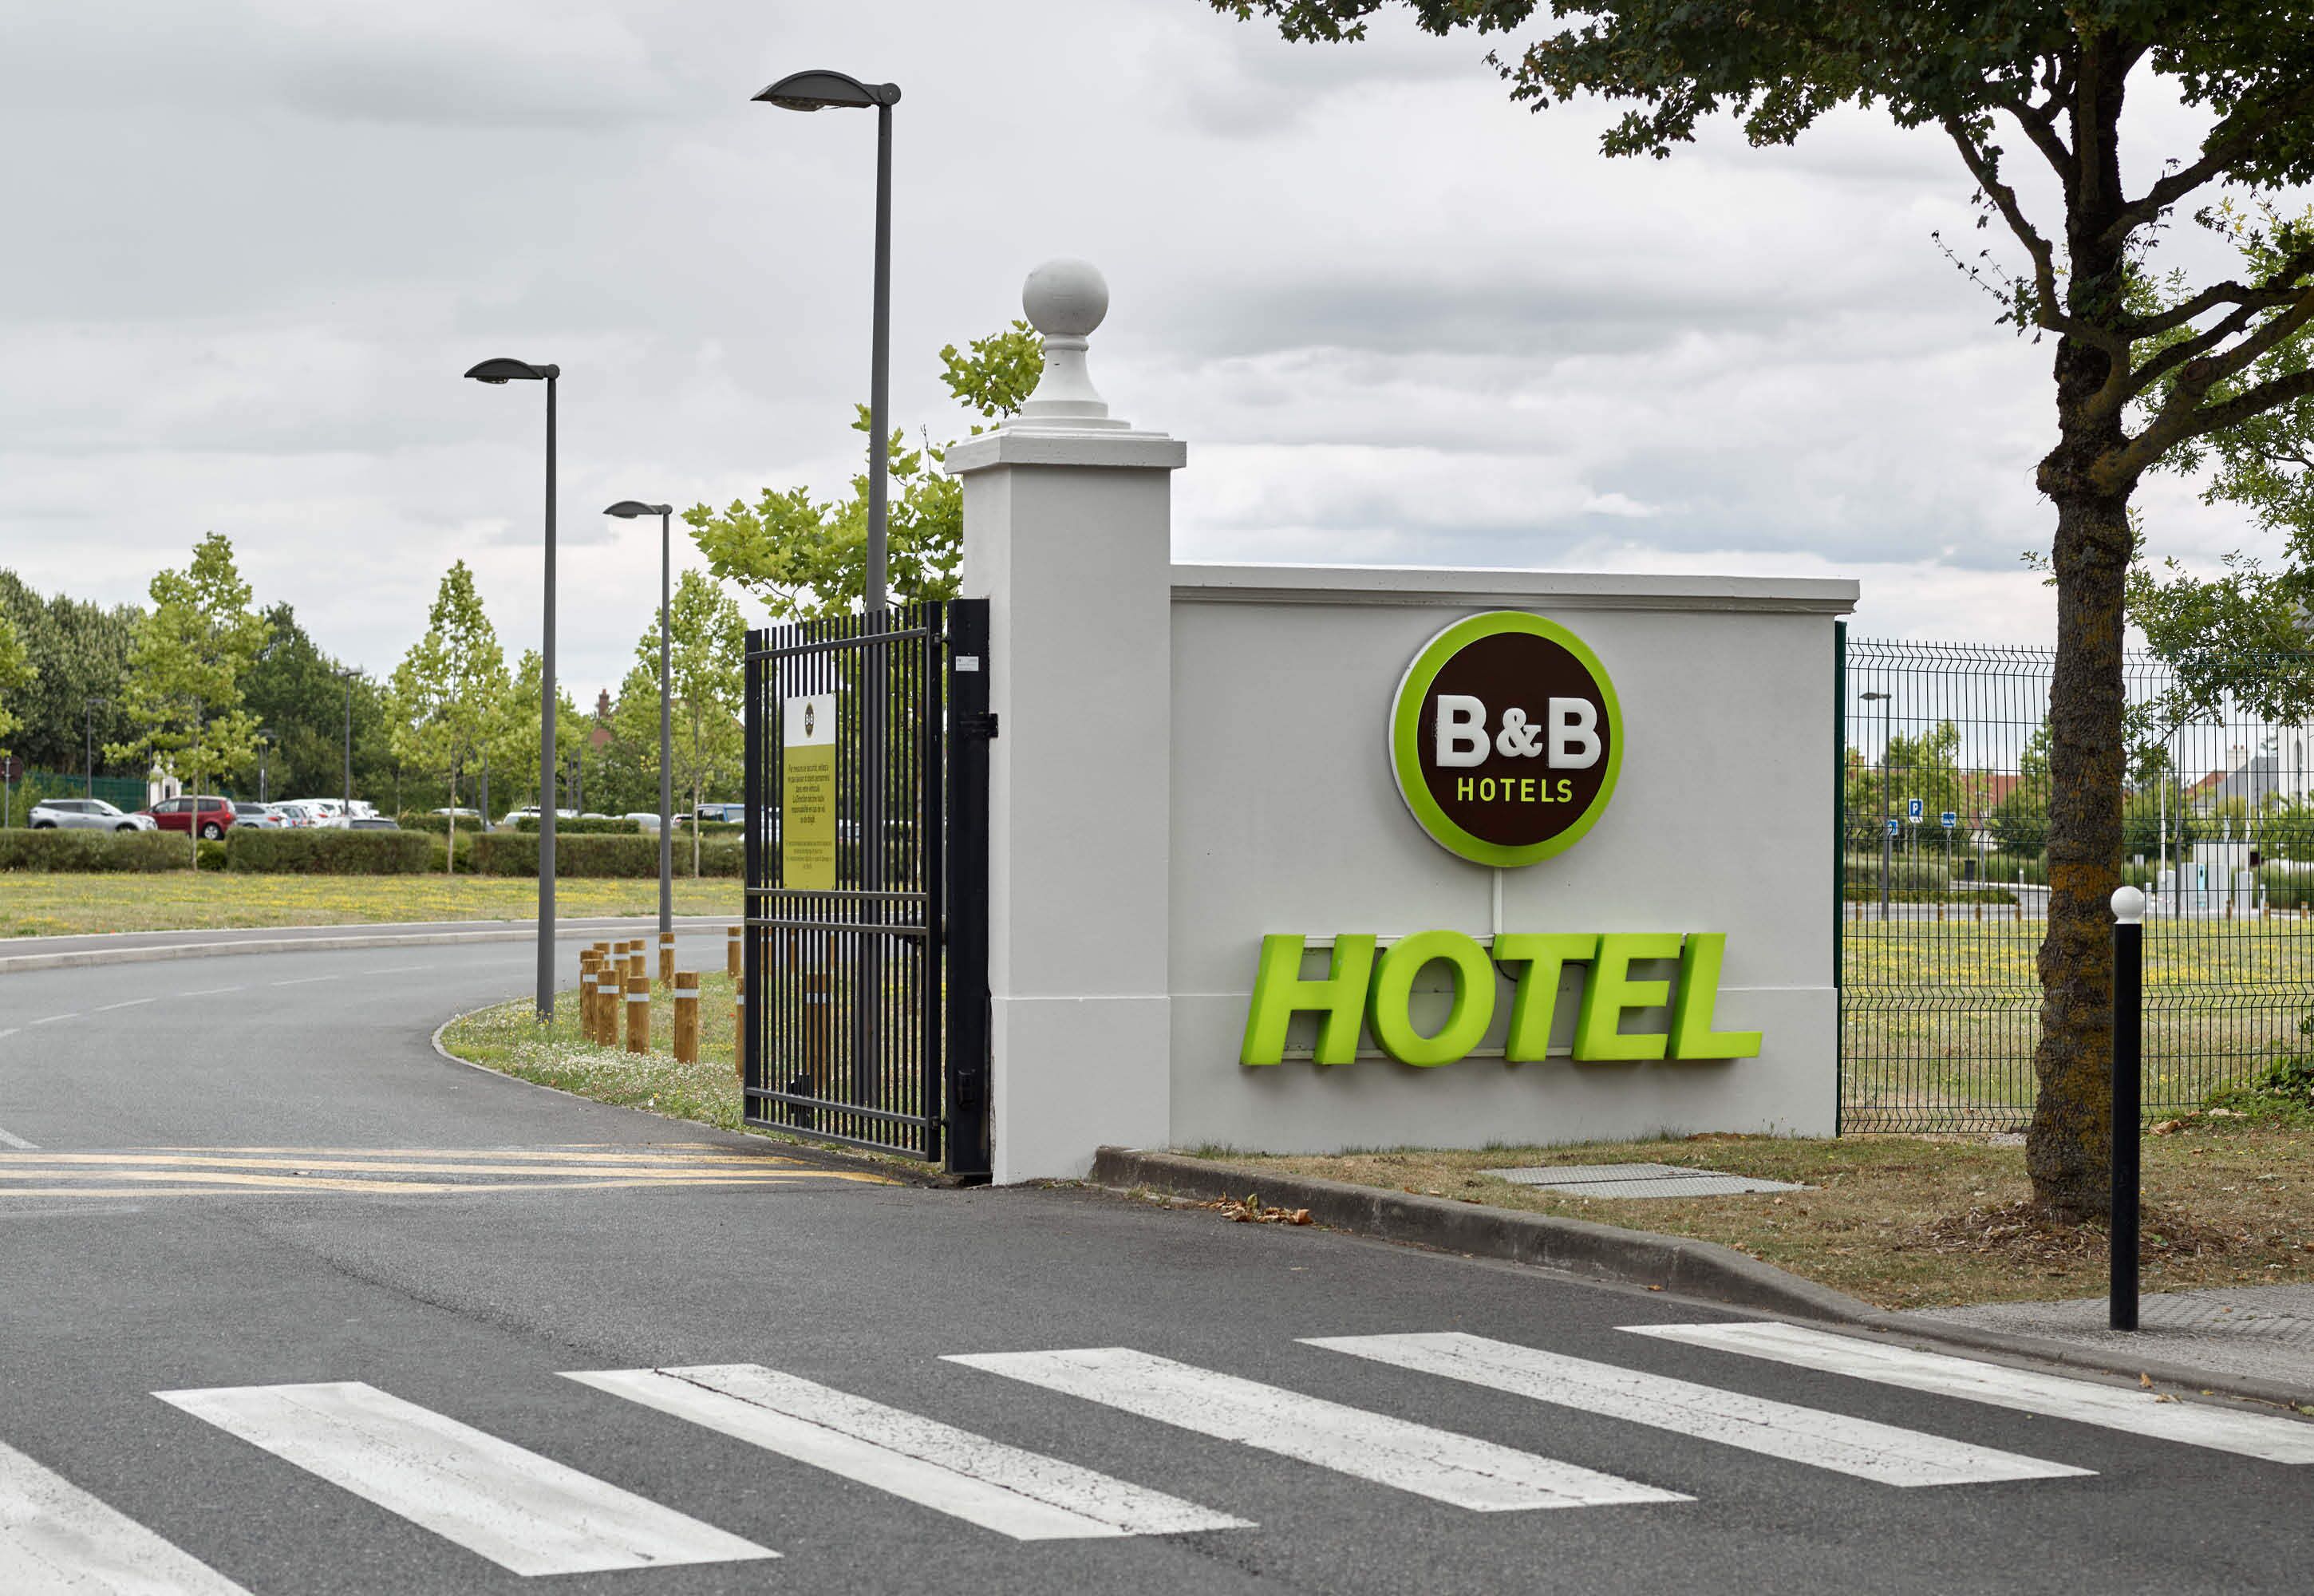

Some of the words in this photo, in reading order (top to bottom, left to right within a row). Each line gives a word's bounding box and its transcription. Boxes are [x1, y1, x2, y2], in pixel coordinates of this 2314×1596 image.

[1436, 694, 1601, 769] B&B
[1457, 777, 1573, 803] HOTELS
[1239, 930, 1763, 1068] HOTEL
